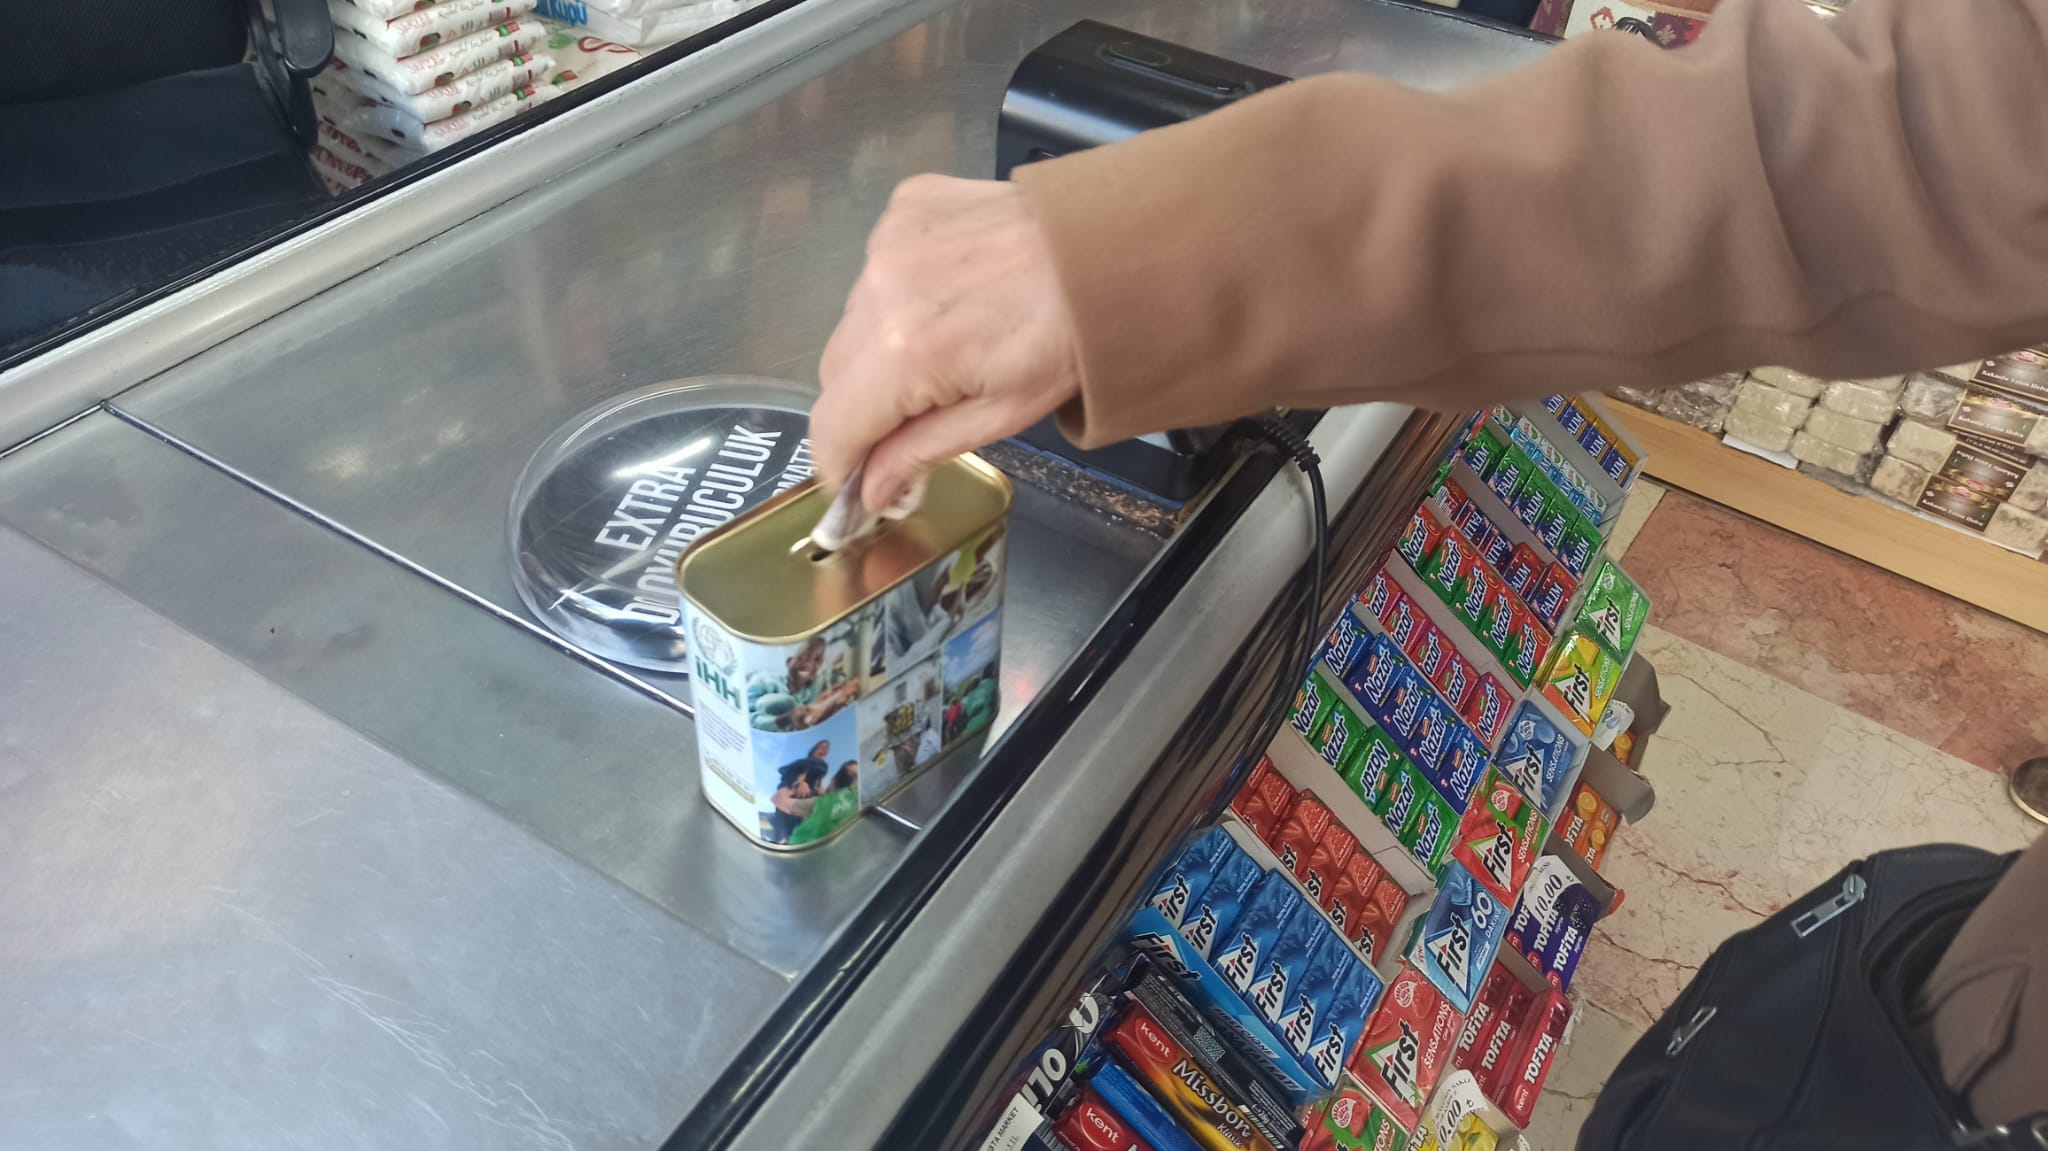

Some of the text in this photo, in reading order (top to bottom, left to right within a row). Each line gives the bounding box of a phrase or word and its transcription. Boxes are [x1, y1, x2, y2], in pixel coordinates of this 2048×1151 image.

[1546, 394, 1564, 414] ALIM
[1567, 413, 1584, 435] ALIM
[1470, 444, 1490, 474] ALIM
[1588, 436, 1606, 457] ALIM
[1609, 457, 1627, 480] ALIM
[1496, 464, 1520, 497] FALIM
[595, 464, 697, 551] EXTRA
[1522, 490, 1544, 523] FALIM
[1545, 513, 1567, 547] FALIM
[1403, 518, 1428, 566] Nazar
[1569, 538, 1590, 573] FALIM
[1438, 546, 1462, 591] Nazar
[1512, 563, 1531, 593] ALIM
[1464, 574, 1488, 622] Nazar
[1540, 583, 1563, 617] FALIM
[1491, 602, 1514, 648] Nazar
[1324, 624, 1355, 676] Nazar
[1422, 638, 1442, 677] azar
[1515, 630, 1537, 678] Nazar
[1364, 650, 1394, 704] Nazar
[1447, 667, 1467, 708] azar
[1563, 663, 1590, 716] First
[1290, 685, 1320, 735] Nazar
[1392, 679, 1422, 736] Nazar
[1477, 688, 1501, 743] Nazar
[1320, 717, 1349, 769] Nazar
[1419, 711, 1447, 768] Nazar
[1361, 739, 1390, 798] Nazar
[1449, 744, 1479, 800] Nazar
[1513, 743, 1542, 791] First
[1385, 778, 1416, 835] Nazar
[1413, 809, 1443, 864] Nazar
[1482, 820, 1513, 889] First
[1517, 809, 1538, 863] SENSATIONS
[1470, 892, 1495, 929] 60
[1514, 904, 1530, 932] TOF
[1534, 874, 1562, 920] 10.00
[1224, 932, 1258, 993] First
[1433, 914, 1470, 986] First
[1255, 961, 1288, 1022] First
[1140, 1022, 1171, 1058] kent
[1283, 993, 1315, 1057] First
[1424, 1000, 1450, 1070] SENSATIONS
[1313, 1023, 1345, 1084] First
[1381, 1018, 1420, 1102] First
[1000, 1106, 1019, 1136] MARKET
[1172, 1059, 1253, 1136] Missbon
[1516, 1089, 1529, 1111] kent
[1085, 1106, 1120, 1144] kent
[1439, 1099, 1462, 1146] 0.00
